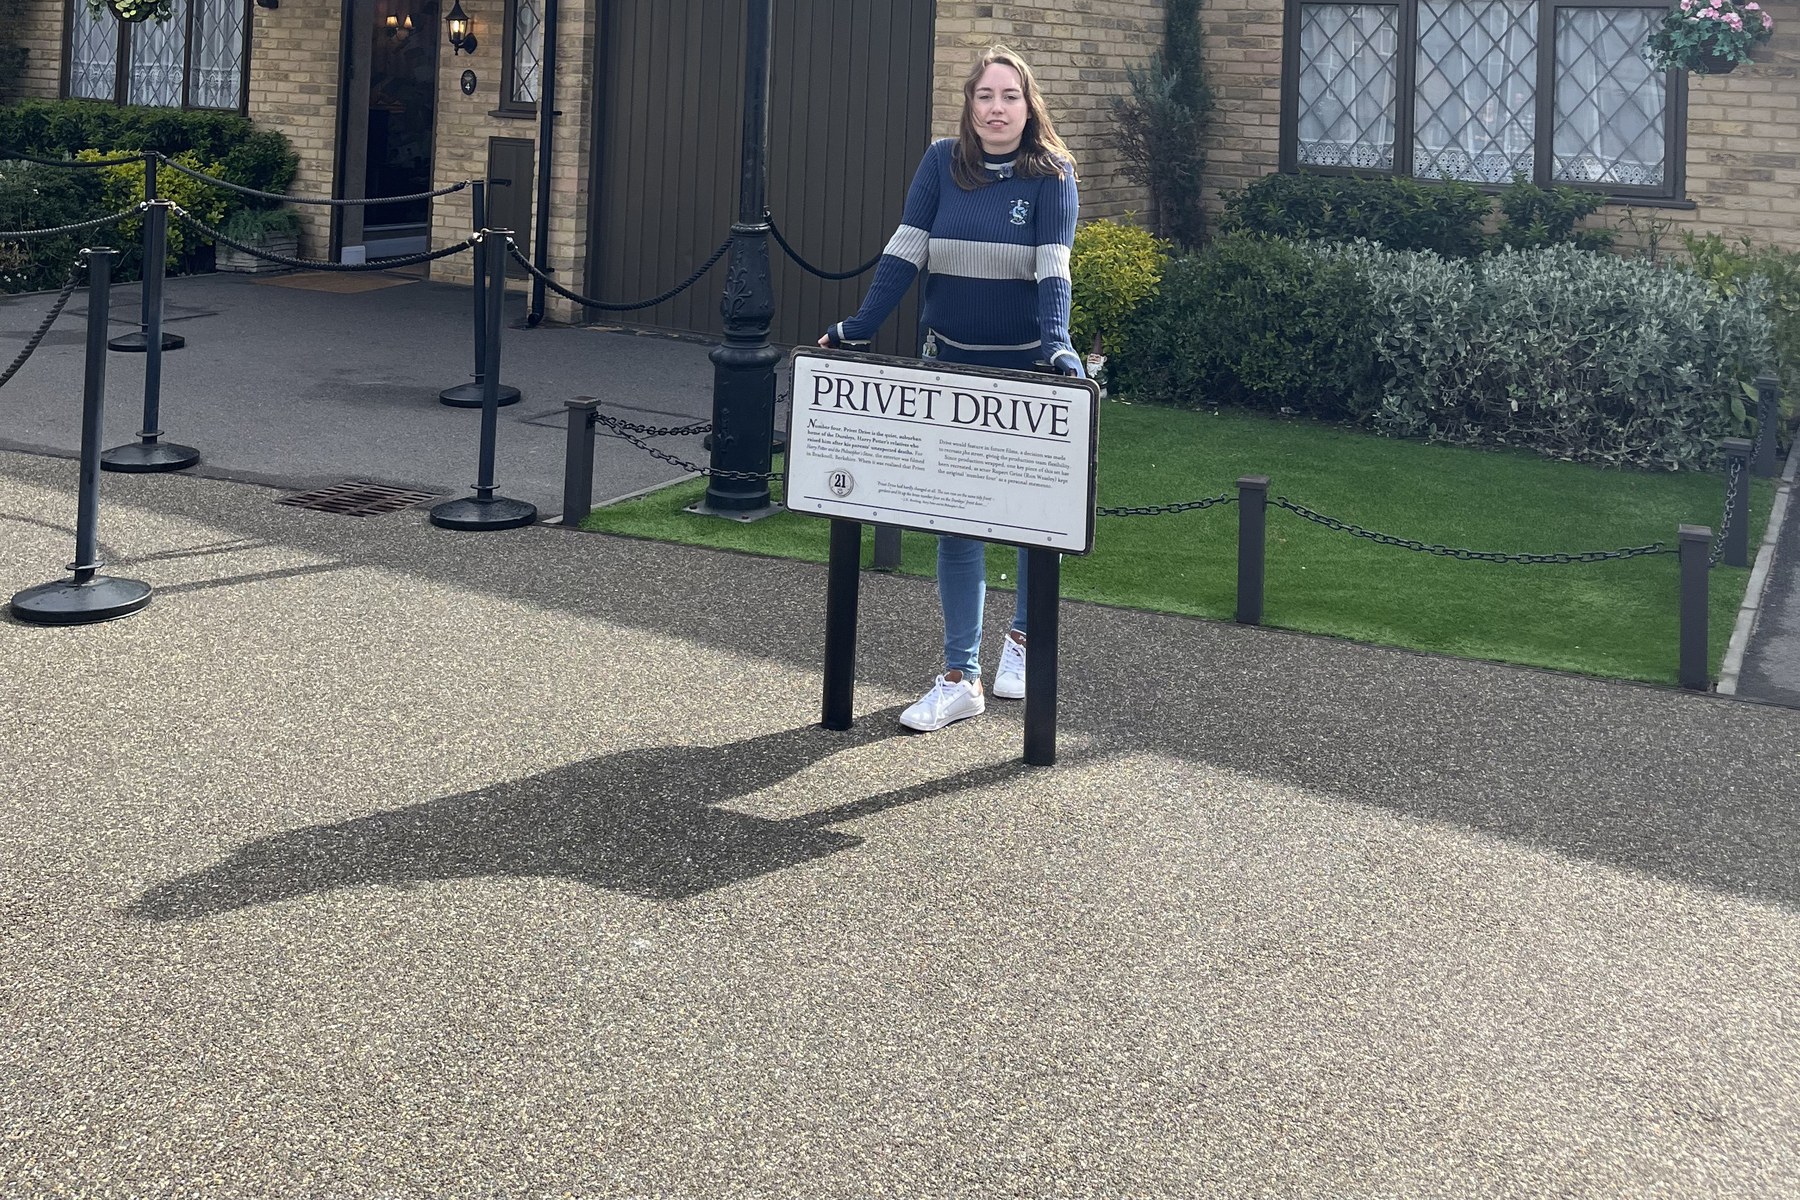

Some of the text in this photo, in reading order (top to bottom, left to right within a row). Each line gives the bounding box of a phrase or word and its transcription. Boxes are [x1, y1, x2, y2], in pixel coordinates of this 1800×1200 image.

[465, 83, 471, 91] 4
[812, 375, 1070, 437] PRIVET DRIVE
[806, 418, 830, 429] Number
[899, 434, 922, 442] suburban
[857, 435, 871, 443] Harry
[870, 445, 897, 453] unexpected
[967, 442, 984, 450] feature
[1024, 450, 1044, 458] decision
[958, 456, 984, 465] production
[986, 453, 1000, 461] giving
[1008, 456, 1034, 465] production
[834, 473, 846, 488] 21
[946, 469, 964, 478] original
[1007, 478, 1028, 486] personal
[992, 468, 1008, 476] Rupert
[1057, 477, 1068, 485] kept
